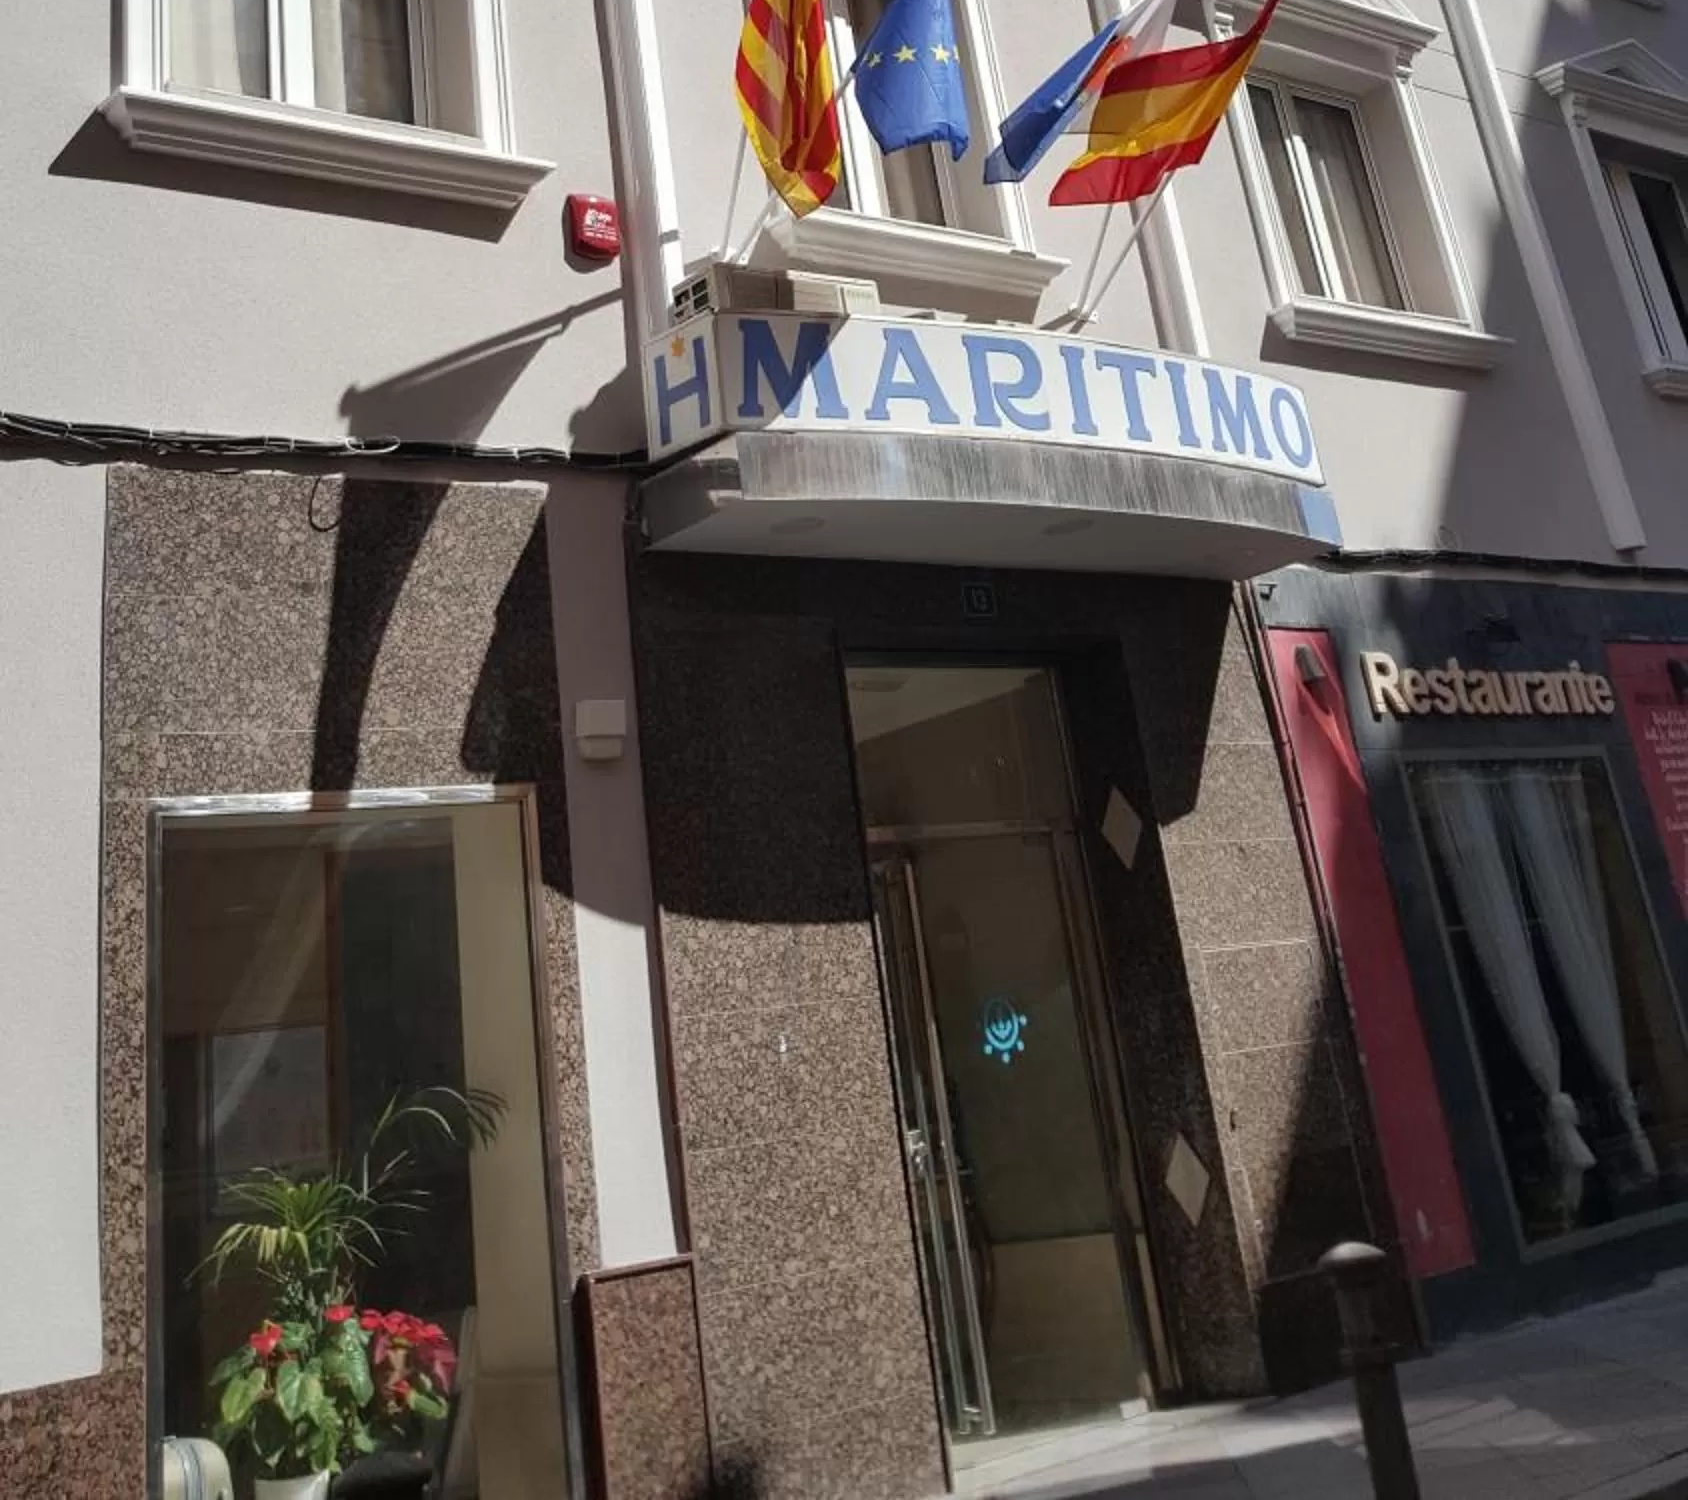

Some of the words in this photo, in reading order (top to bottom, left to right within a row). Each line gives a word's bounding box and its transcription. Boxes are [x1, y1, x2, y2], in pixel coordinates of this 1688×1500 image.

[653, 337, 709, 446] H
[737, 318, 1314, 469] MARITIMO
[1360, 650, 1616, 721] Restaurante
